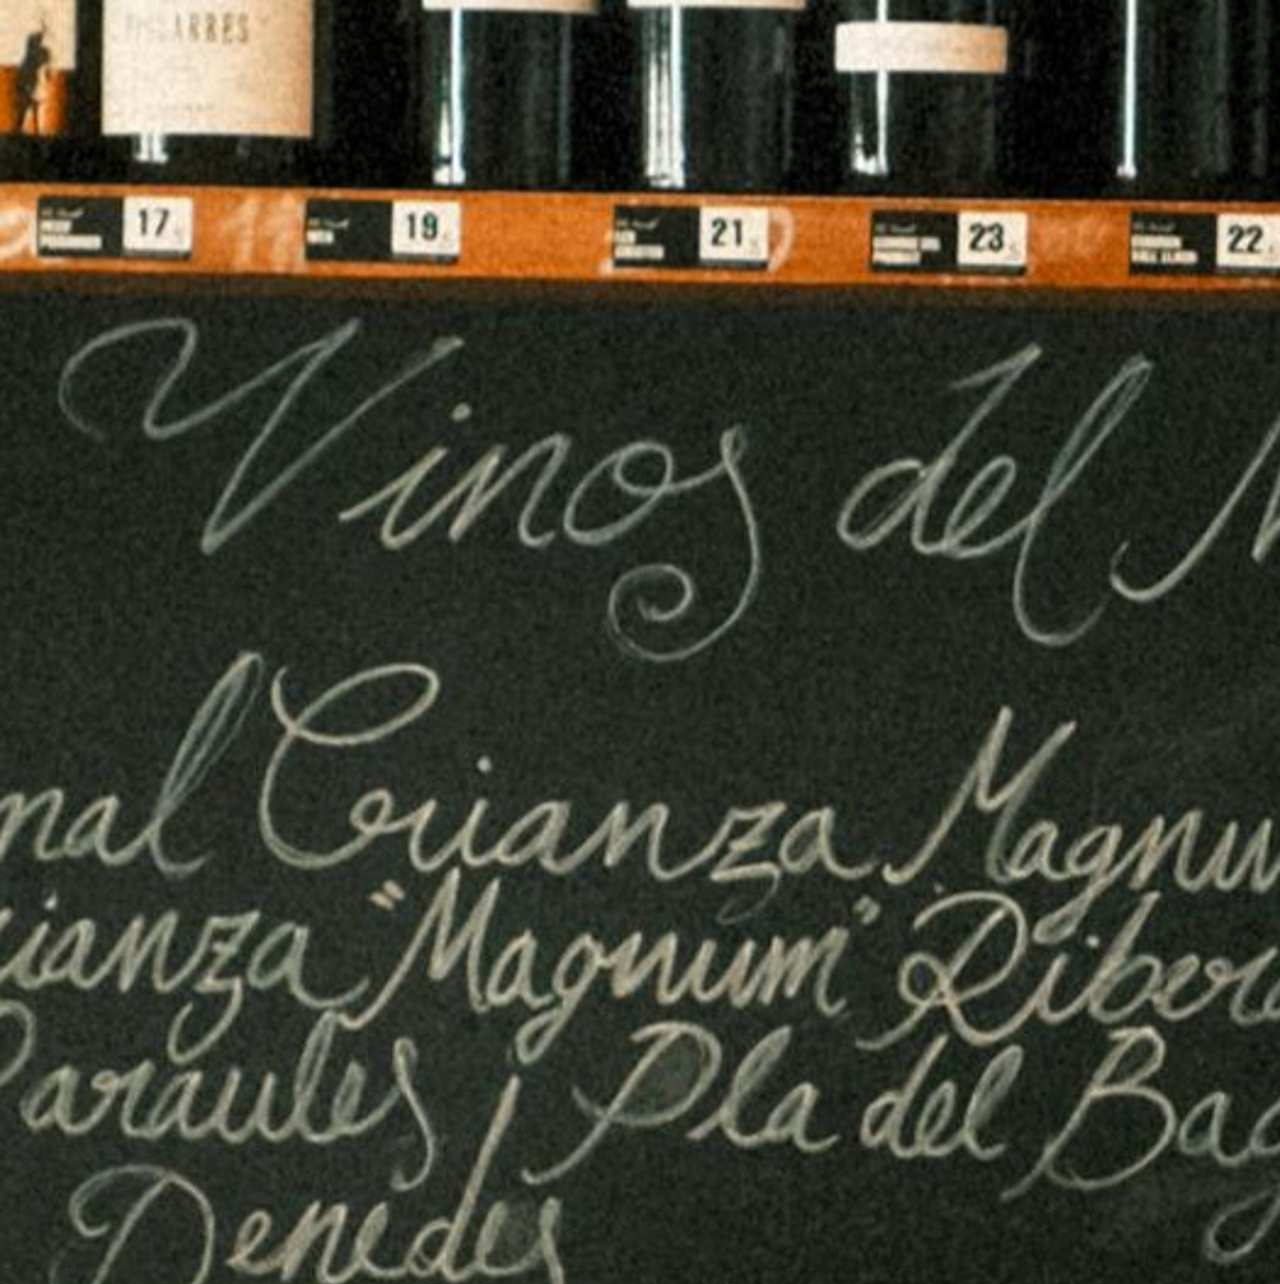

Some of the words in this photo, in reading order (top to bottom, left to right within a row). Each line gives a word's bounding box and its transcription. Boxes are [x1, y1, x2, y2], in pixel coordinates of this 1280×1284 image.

[138, 207, 170, 238] 17
[407, 211, 439, 242] 19
[710, 217, 744, 247] 21
[968, 221, 1007, 253] 23
[1226, 223, 1264, 254] 22
[59, 316, 763, 662] Vinos
[837, 342, 1155, 648] del
[258, 661, 874, 926] Crianza
[0, 888, 370, 1066] ianza
[0, 1000, 436, 1193] araules
[520, 1020, 840, 1186] Pla
[859, 1034, 1009, 1160] del
